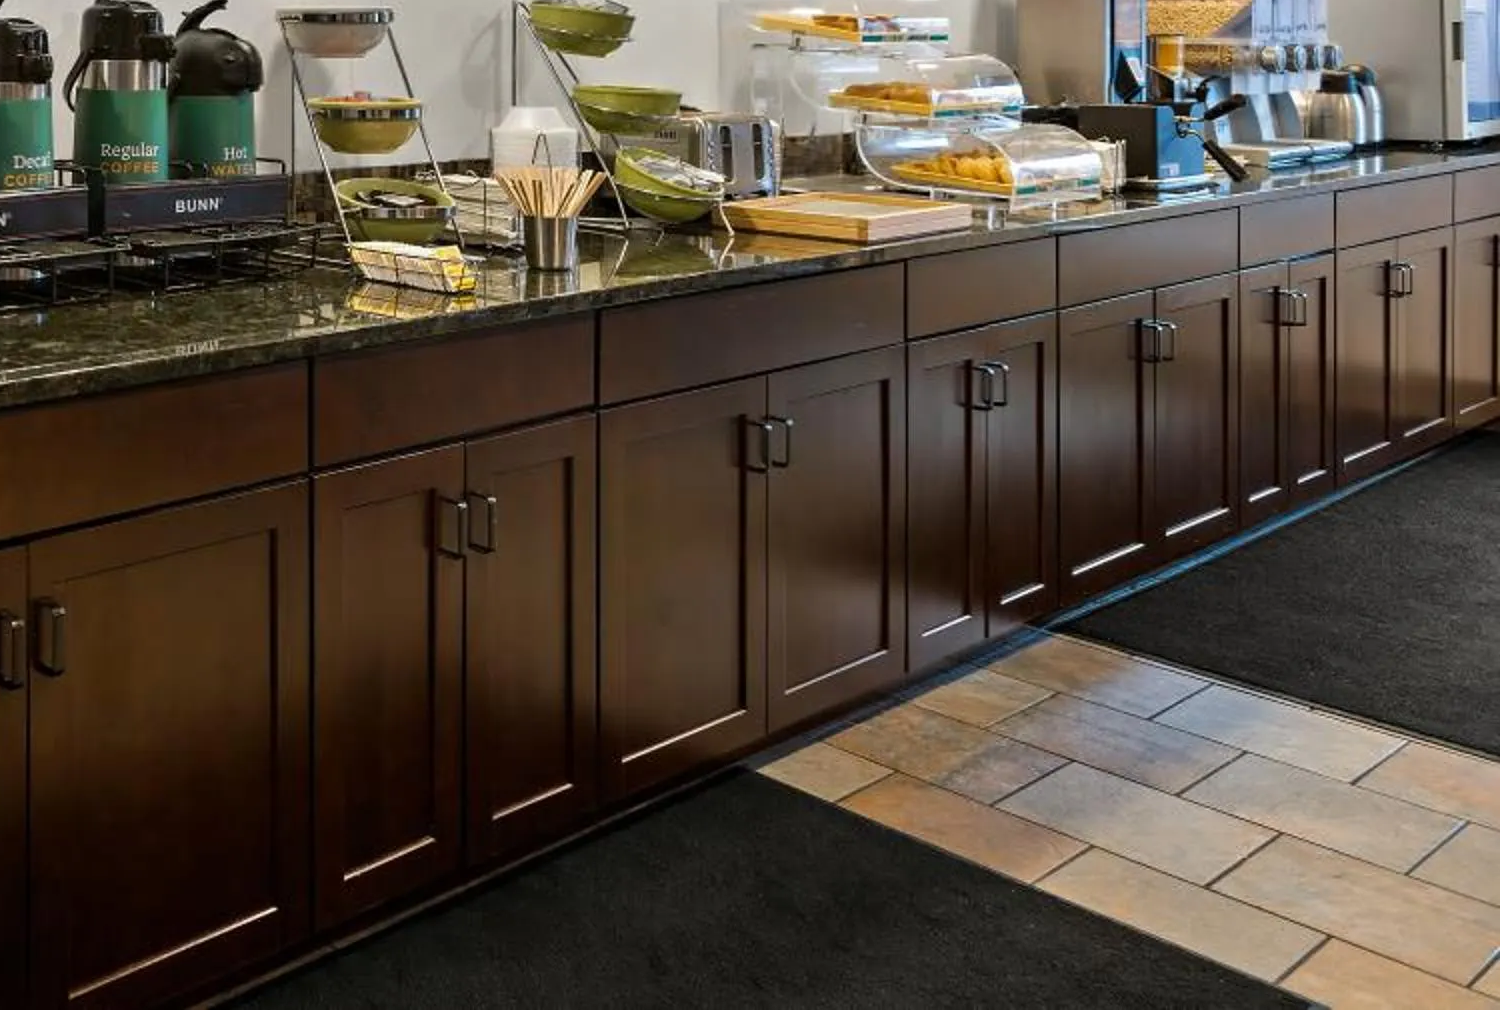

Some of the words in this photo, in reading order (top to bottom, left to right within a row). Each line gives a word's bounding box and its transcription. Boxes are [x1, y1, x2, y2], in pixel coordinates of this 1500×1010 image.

[100, 142, 160, 161] Regular
[223, 146, 248, 161] Hot
[101, 161, 159, 174] COFFEE
[175, 198, 219, 213] BUNN
